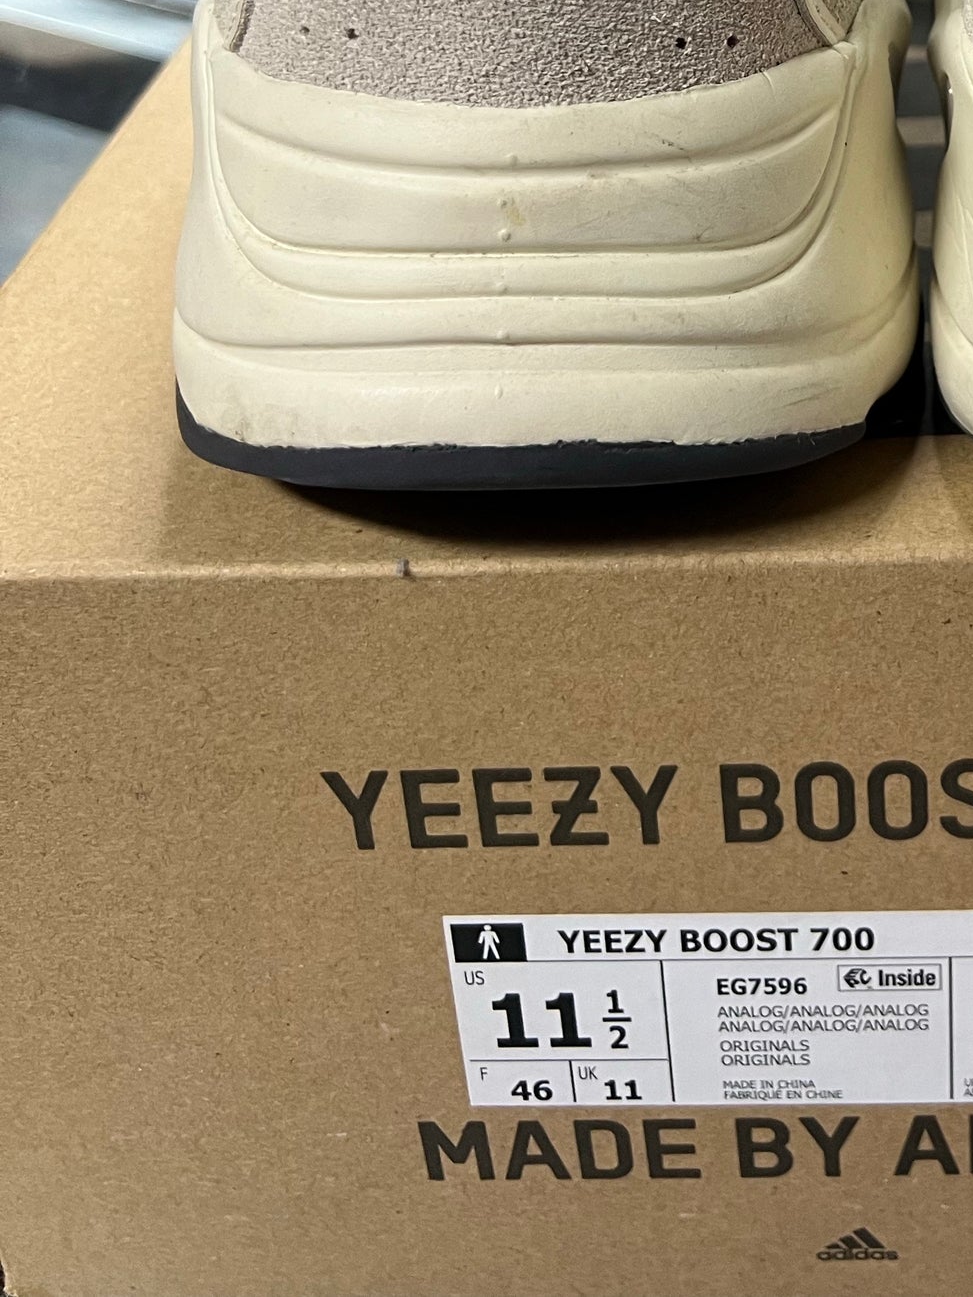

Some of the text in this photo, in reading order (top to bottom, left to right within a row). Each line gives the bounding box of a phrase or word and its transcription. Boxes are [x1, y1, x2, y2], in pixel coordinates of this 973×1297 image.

[320, 764, 679, 851] YEEZY
[558, 927, 875, 954] YEEZY BOOST 700
[463, 970, 485, 986] US
[878, 968, 936, 987] Inside
[716, 977, 808, 996] EG7596
[717, 1003, 930, 1019] ANALOG/ANALOG/ANALOG
[491, 992, 593, 1049] 11
[718, 1018, 931, 1034] ANALOG/ANALOG/ANALOG
[719, 1039, 810, 1053] ORIGINALS
[720, 1053, 811, 1067] ORIGINALS
[479, 1066, 488, 1081] F
[577, 1066, 599, 1081] UK
[511, 1079, 553, 1101] 46
[603, 1079, 642, 1101] 11
[722, 1079, 816, 1090] MADE IN CHINA
[723, 1089, 844, 1101] FABRIQUE EN CHINE
[417, 1118, 702, 1181] MADE
[734, 1116, 861, 1179] BY
[816, 1248, 899, 1261] adidas
